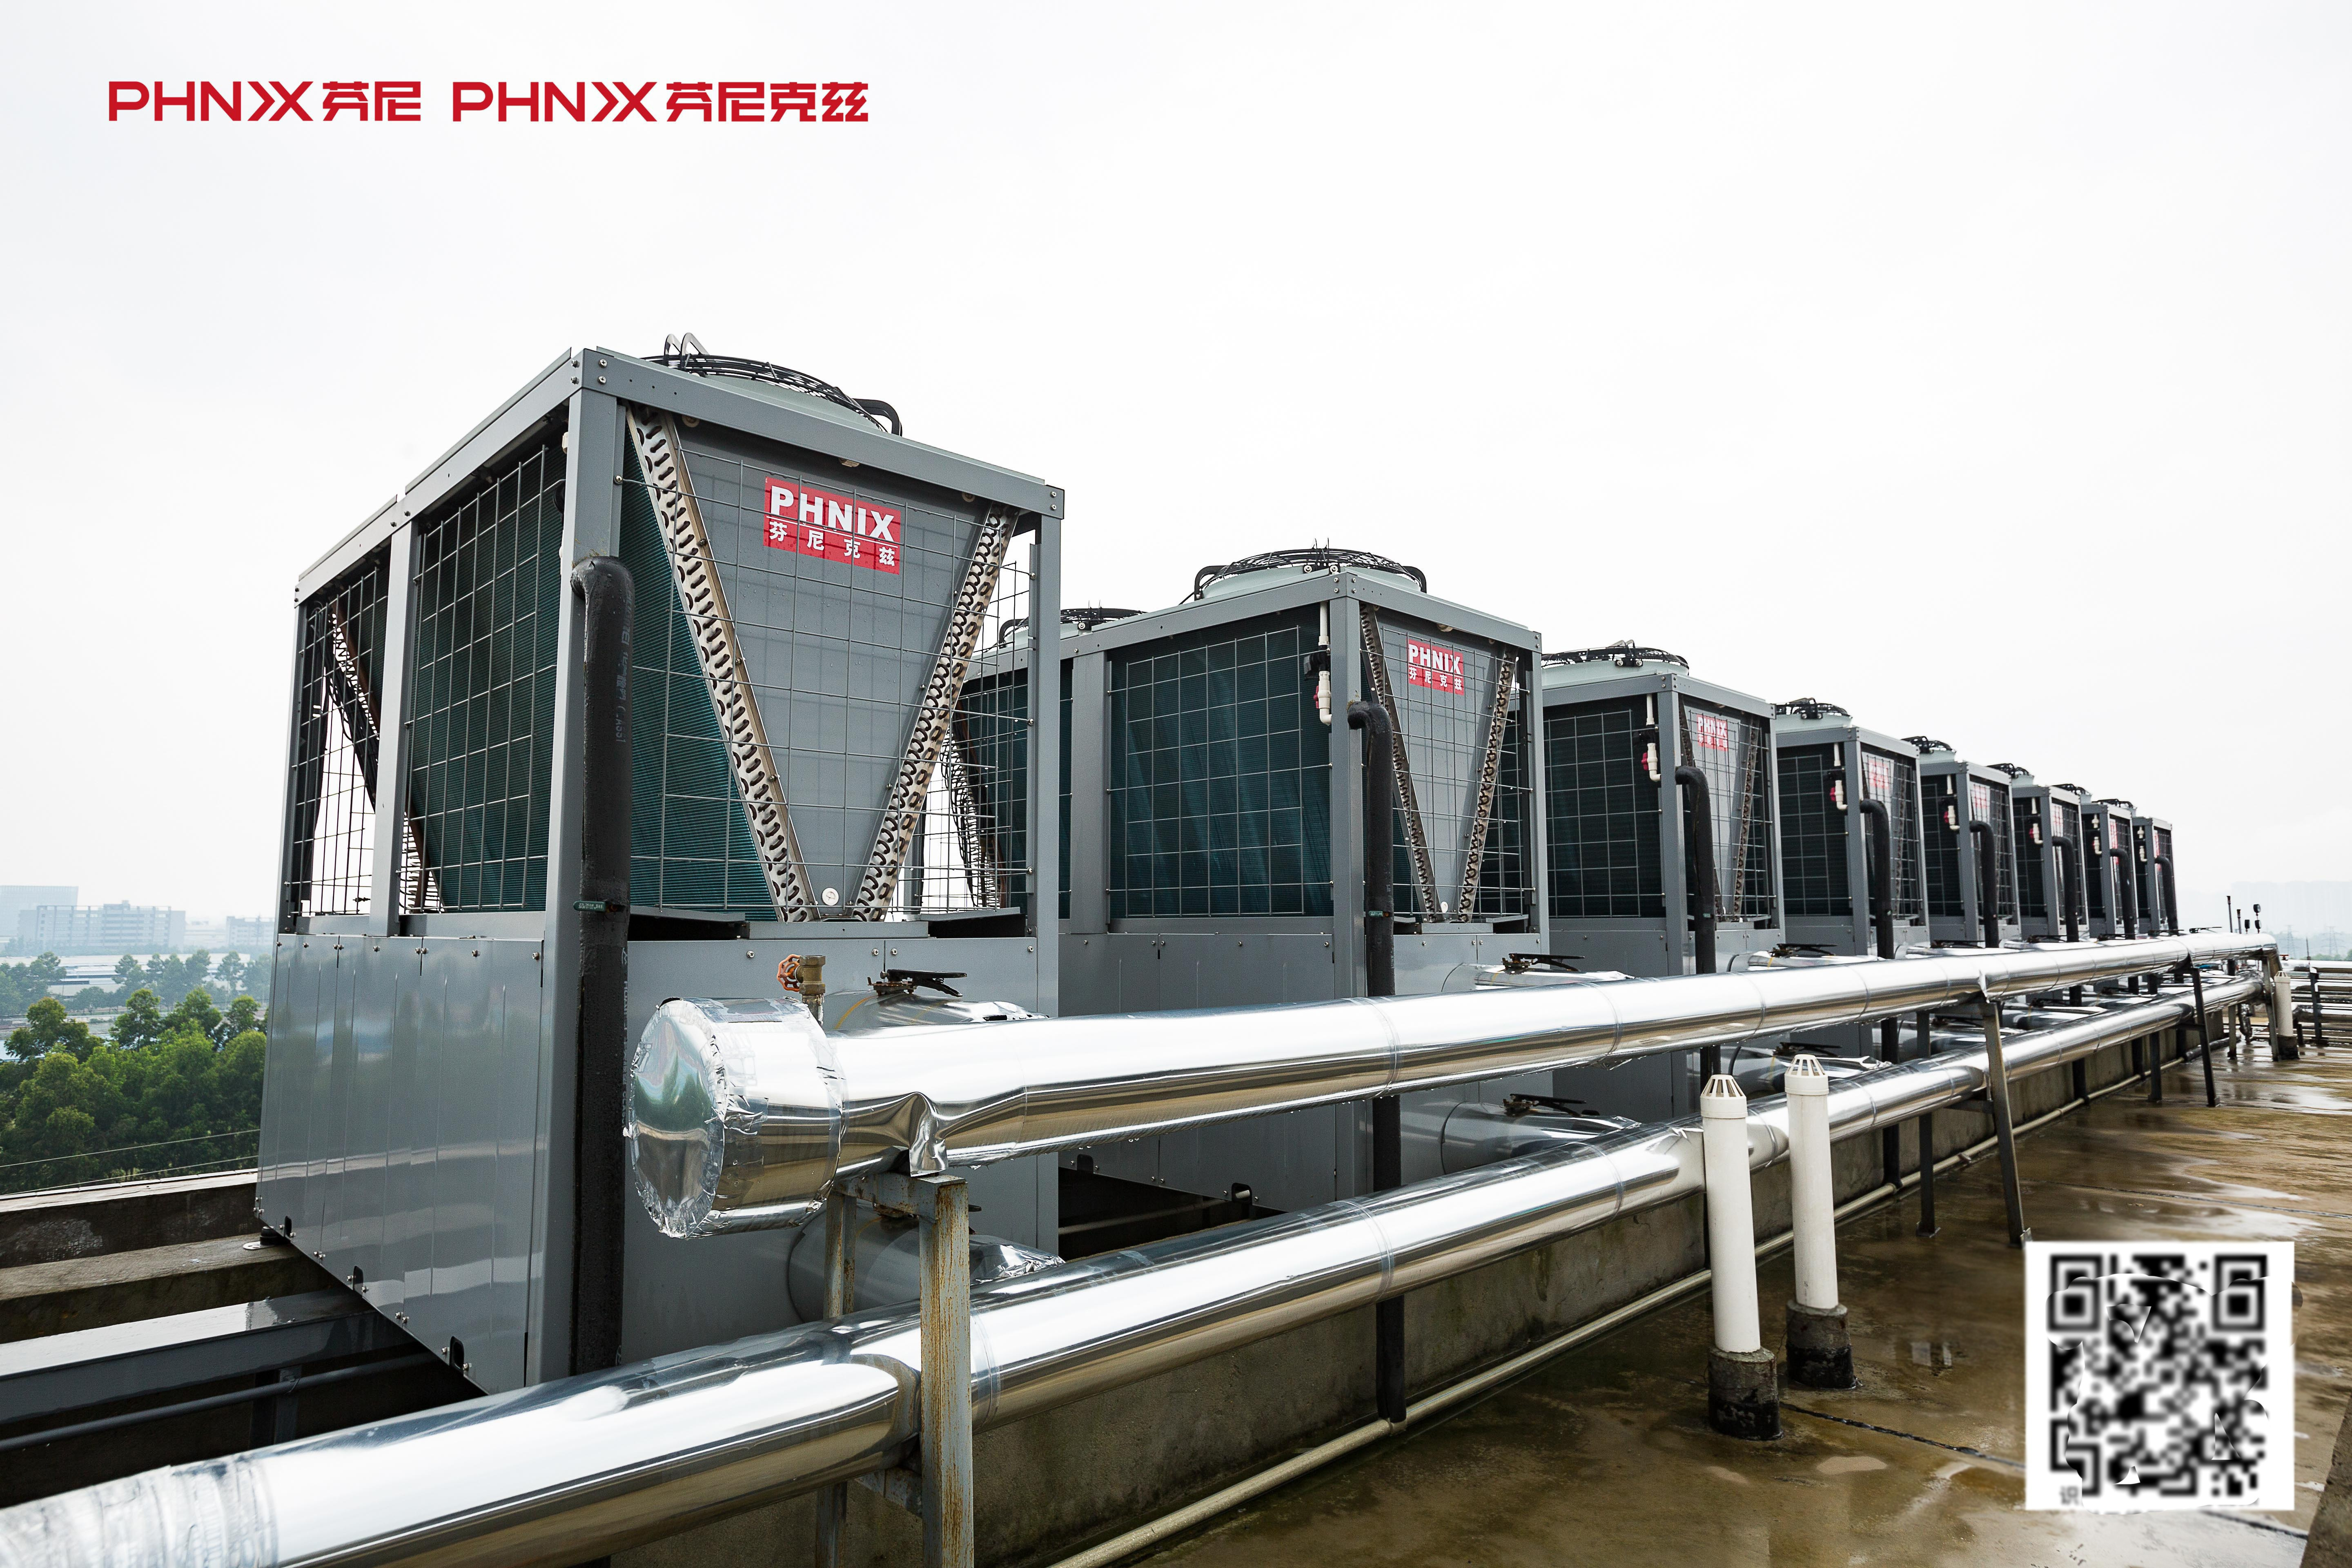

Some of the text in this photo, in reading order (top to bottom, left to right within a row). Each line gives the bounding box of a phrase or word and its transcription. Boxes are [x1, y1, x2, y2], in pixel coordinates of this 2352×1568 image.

[770, 485, 895, 542] PHNIX
[769, 521, 895, 567] 芬尼克兹
[1408, 644, 1461, 675] PHNIX
[1697, 717, 1726, 738] PHNIX
